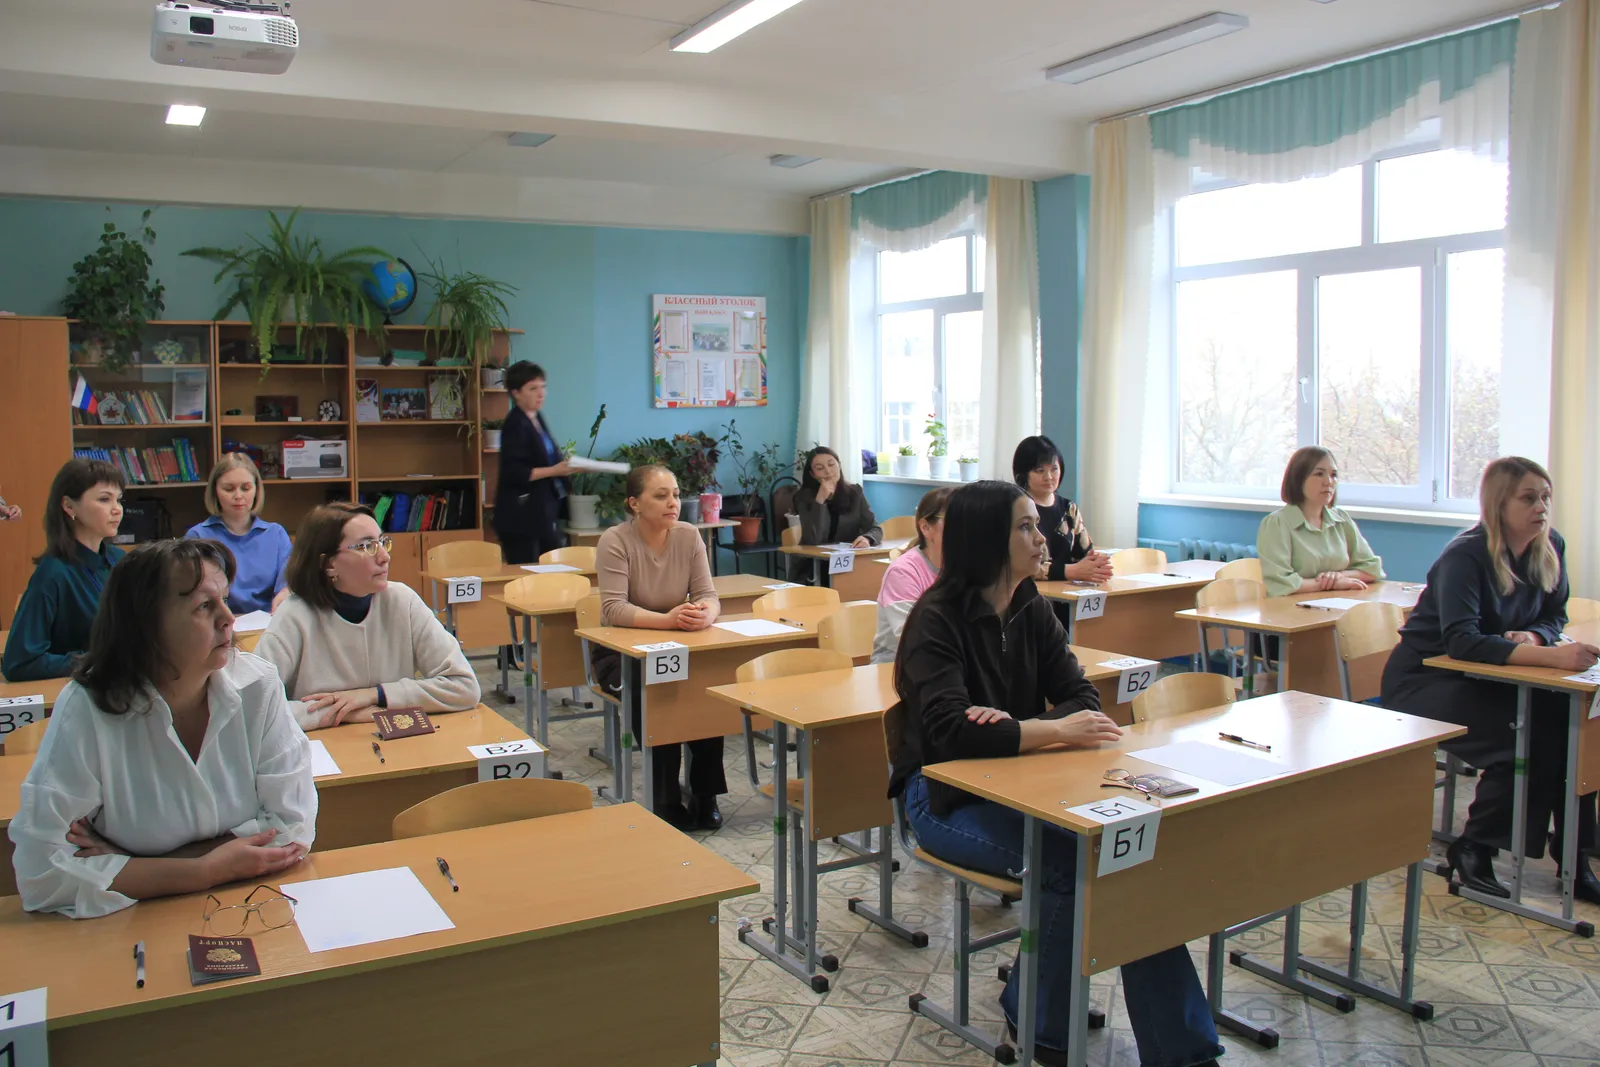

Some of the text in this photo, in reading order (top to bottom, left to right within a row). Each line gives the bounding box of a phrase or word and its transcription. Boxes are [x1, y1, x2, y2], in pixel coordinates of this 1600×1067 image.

[228, 24, 248, 32] EPSON
[664, 296, 756, 307] КЛАССНЫЙ УГОЛОК
[833, 556, 850, 569] А5
[455, 583, 476, 597] Б5
[1081, 596, 1101, 613] А3
[655, 654, 681, 675] Б3
[1126, 671, 1151, 693] Б2
[485, 743, 529, 755] В2
[1088, 802, 1137, 818] Б1
[1112, 822, 1147, 860] Б1
